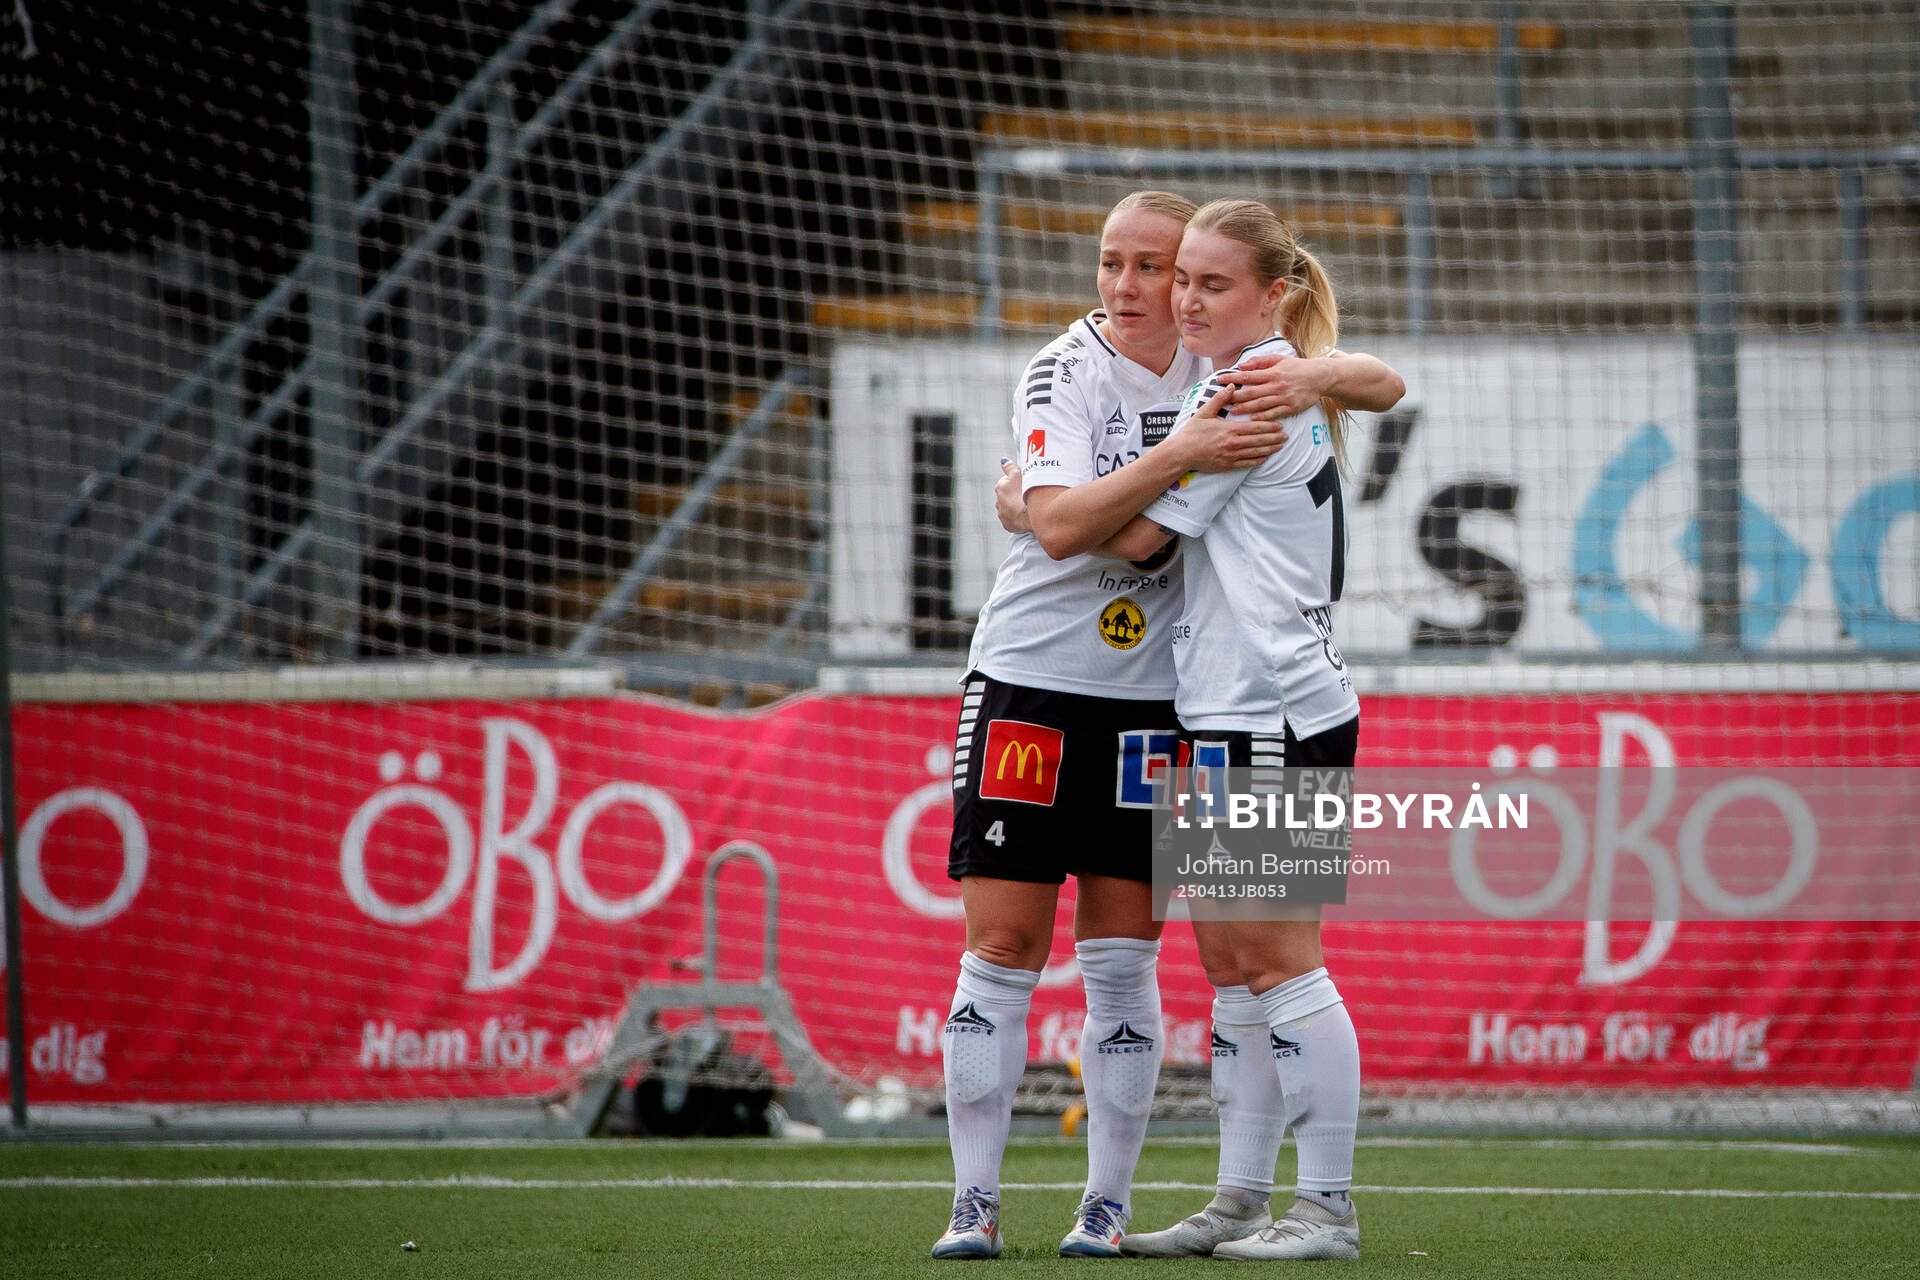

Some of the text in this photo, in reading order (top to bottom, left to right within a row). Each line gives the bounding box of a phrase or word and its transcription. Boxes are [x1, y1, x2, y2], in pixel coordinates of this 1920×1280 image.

[1106, 427, 1128, 436] ELECT
[341, 719, 693, 992] ÖBO
[985, 820, 1006, 847] 4
[1449, 711, 1819, 985] ÖBO
[360, 1020, 468, 1069] Hem
[480, 1015, 549, 1067] för
[1098, 1045, 1153, 1055] SELECT
[1467, 1013, 1588, 1063] Hem
[1603, 1011, 1674, 1062] för
